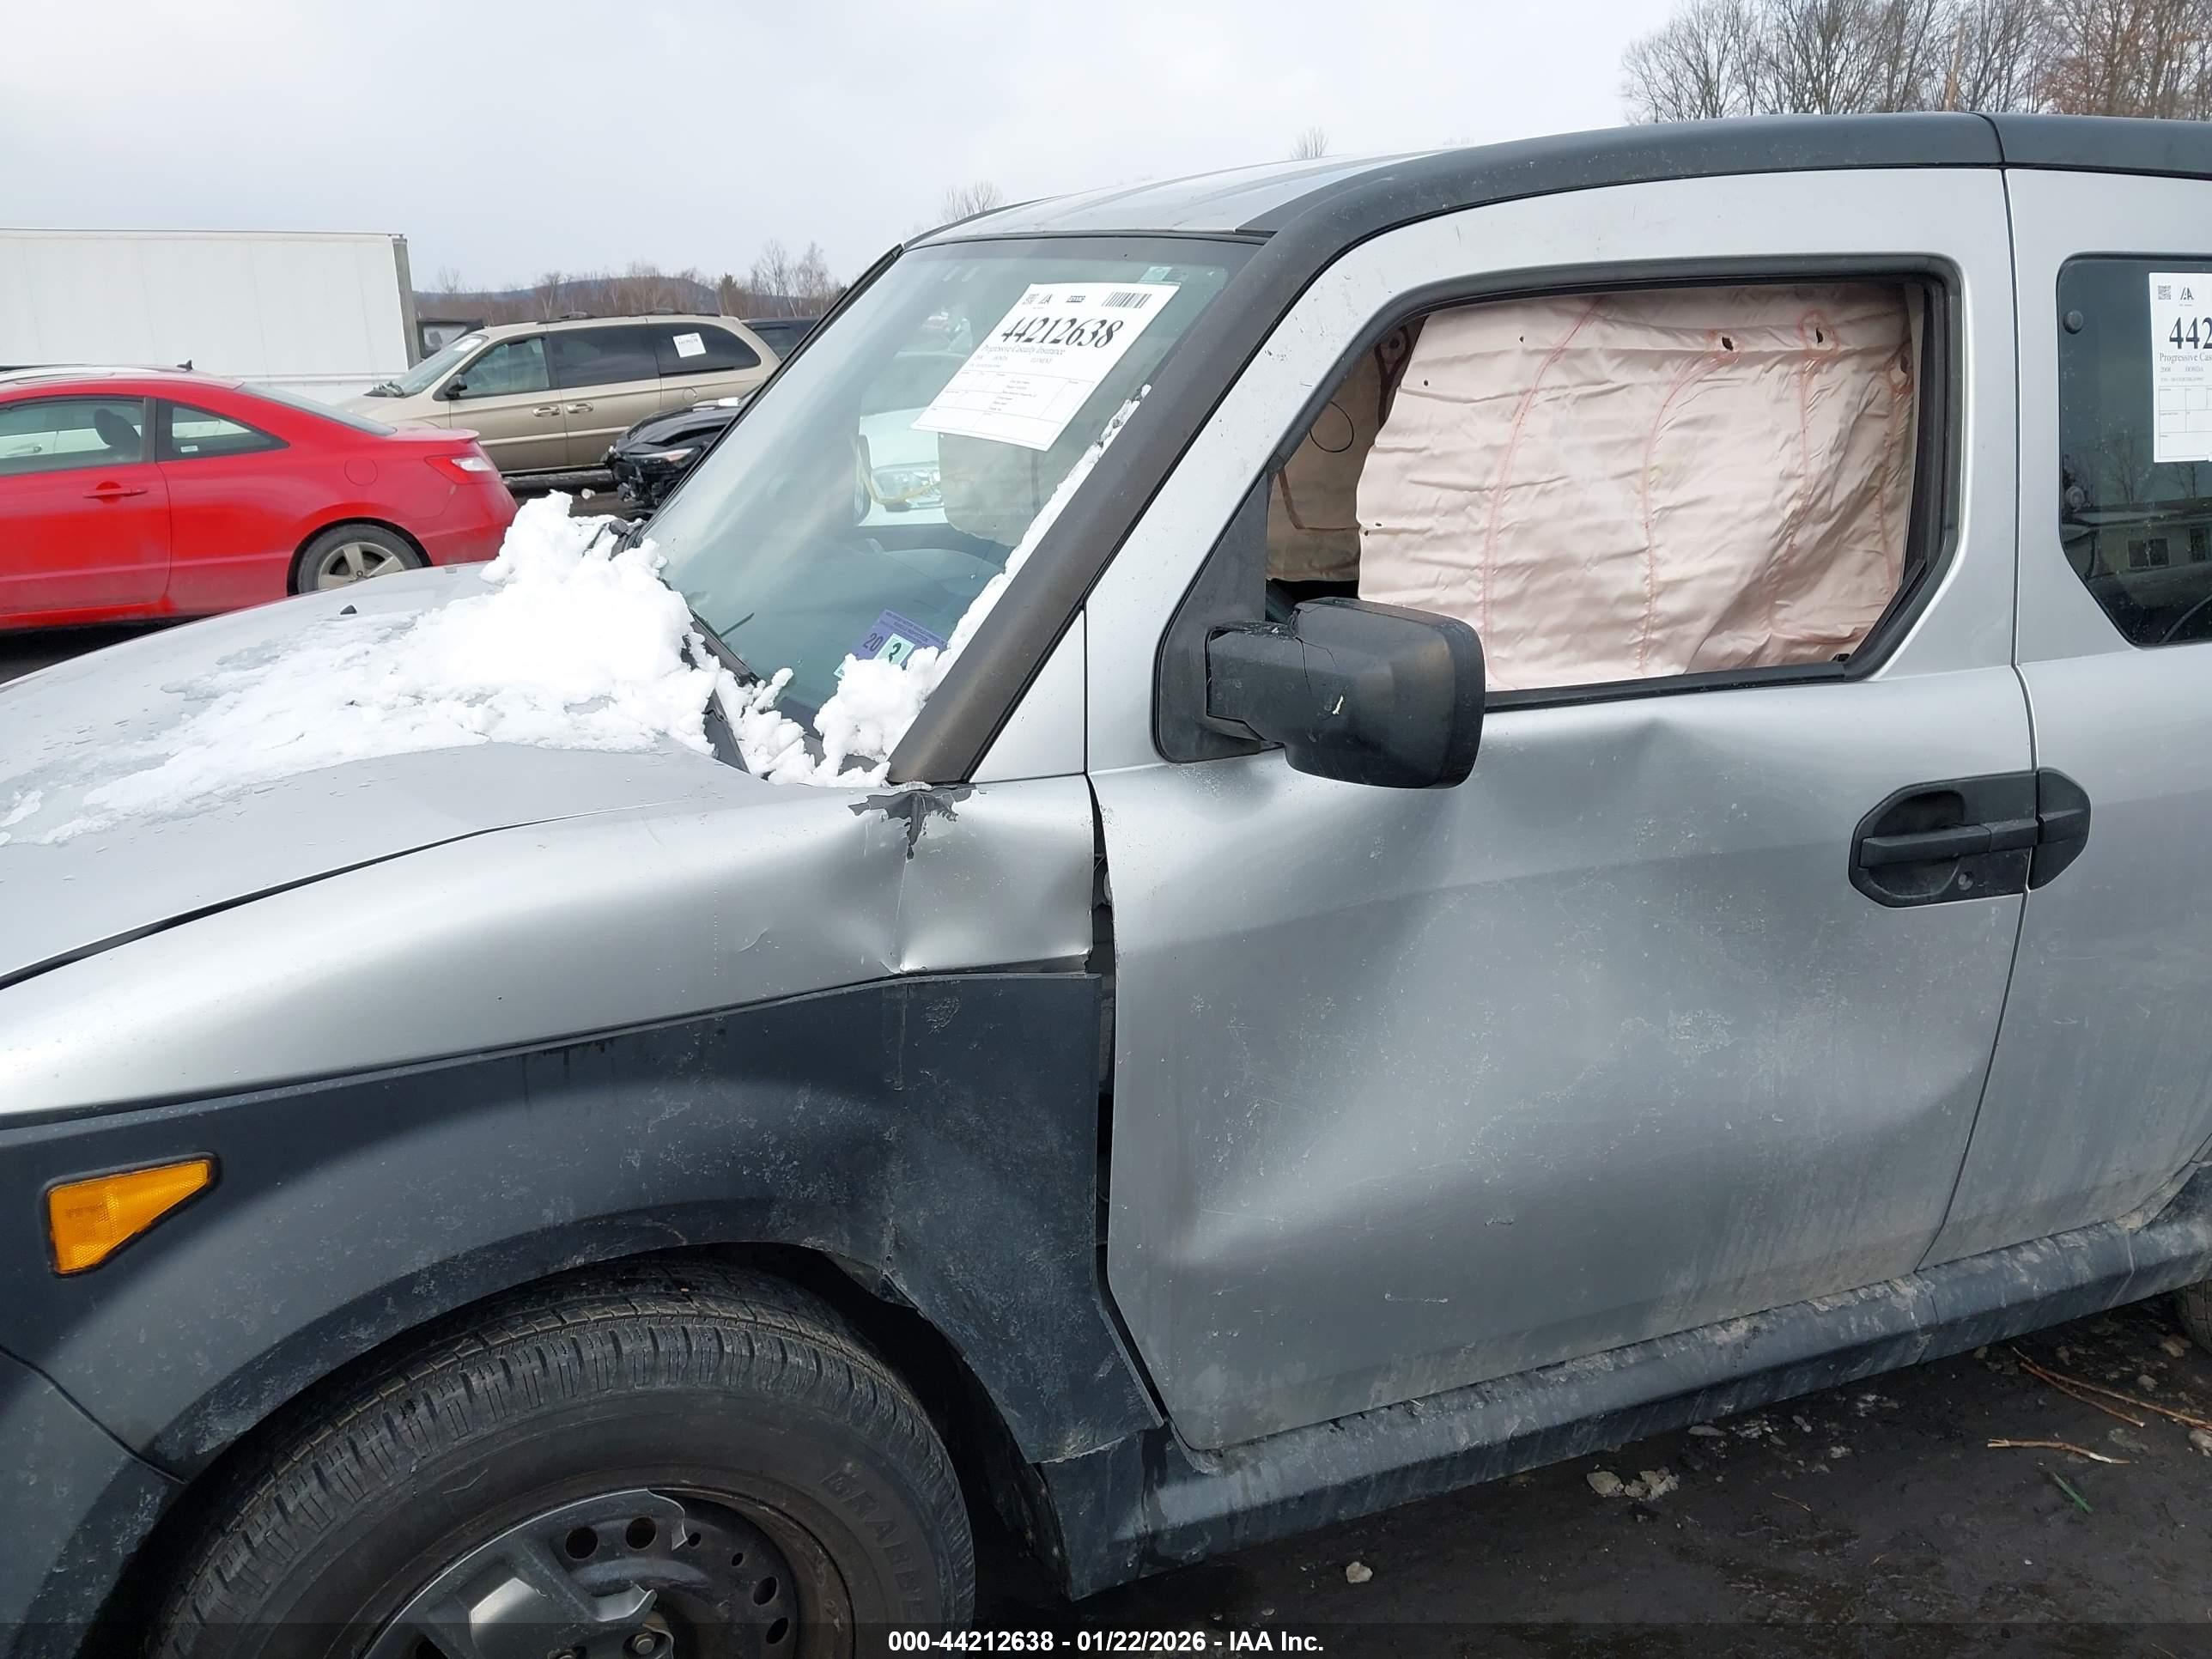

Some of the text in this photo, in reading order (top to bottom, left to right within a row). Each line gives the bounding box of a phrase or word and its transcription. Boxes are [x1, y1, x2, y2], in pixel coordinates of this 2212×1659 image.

[1001, 316, 1124, 349] 44212638
[2160, 352, 2197, 364] Progressive
[862, 632, 884, 652] 20
